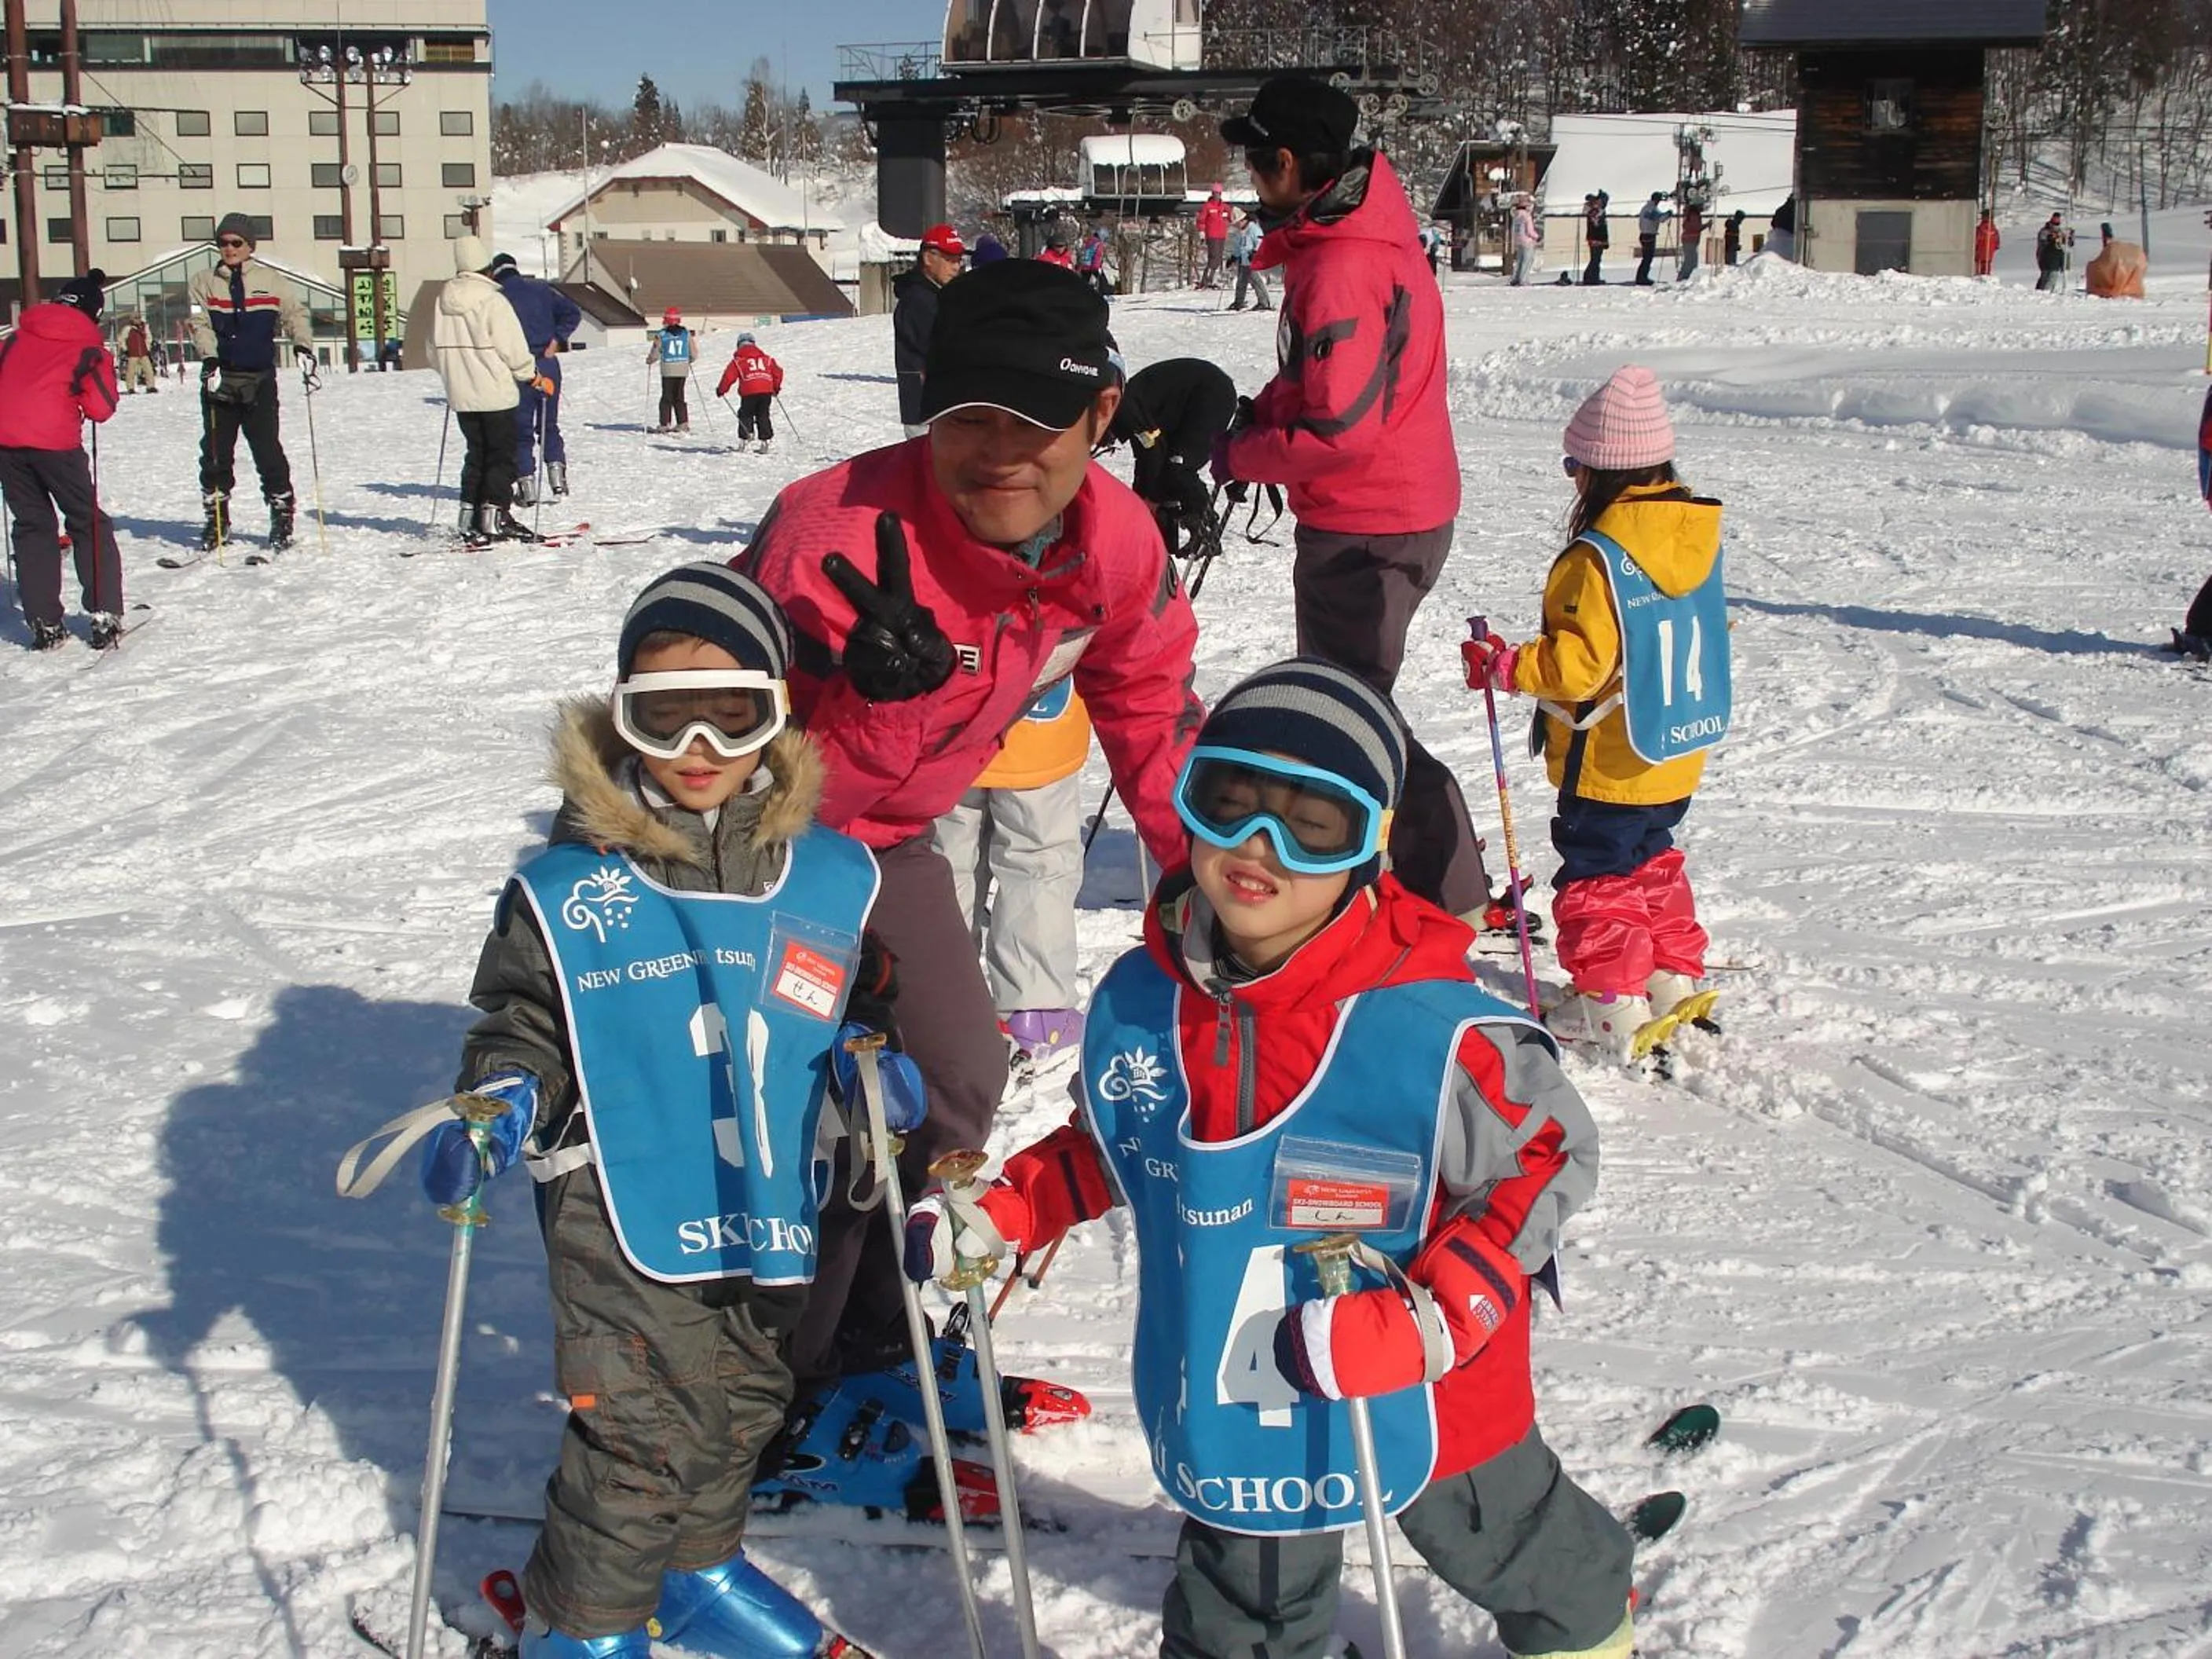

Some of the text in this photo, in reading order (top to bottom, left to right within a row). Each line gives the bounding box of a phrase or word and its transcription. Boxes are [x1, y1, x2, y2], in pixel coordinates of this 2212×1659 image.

[668, 340, 683, 355] 47
[747, 357, 767, 372] 34
[577, 968, 621, 992] NEW
[1181, 1197, 1254, 1226] tsunan
[1216, 1243, 1300, 1427] 4
